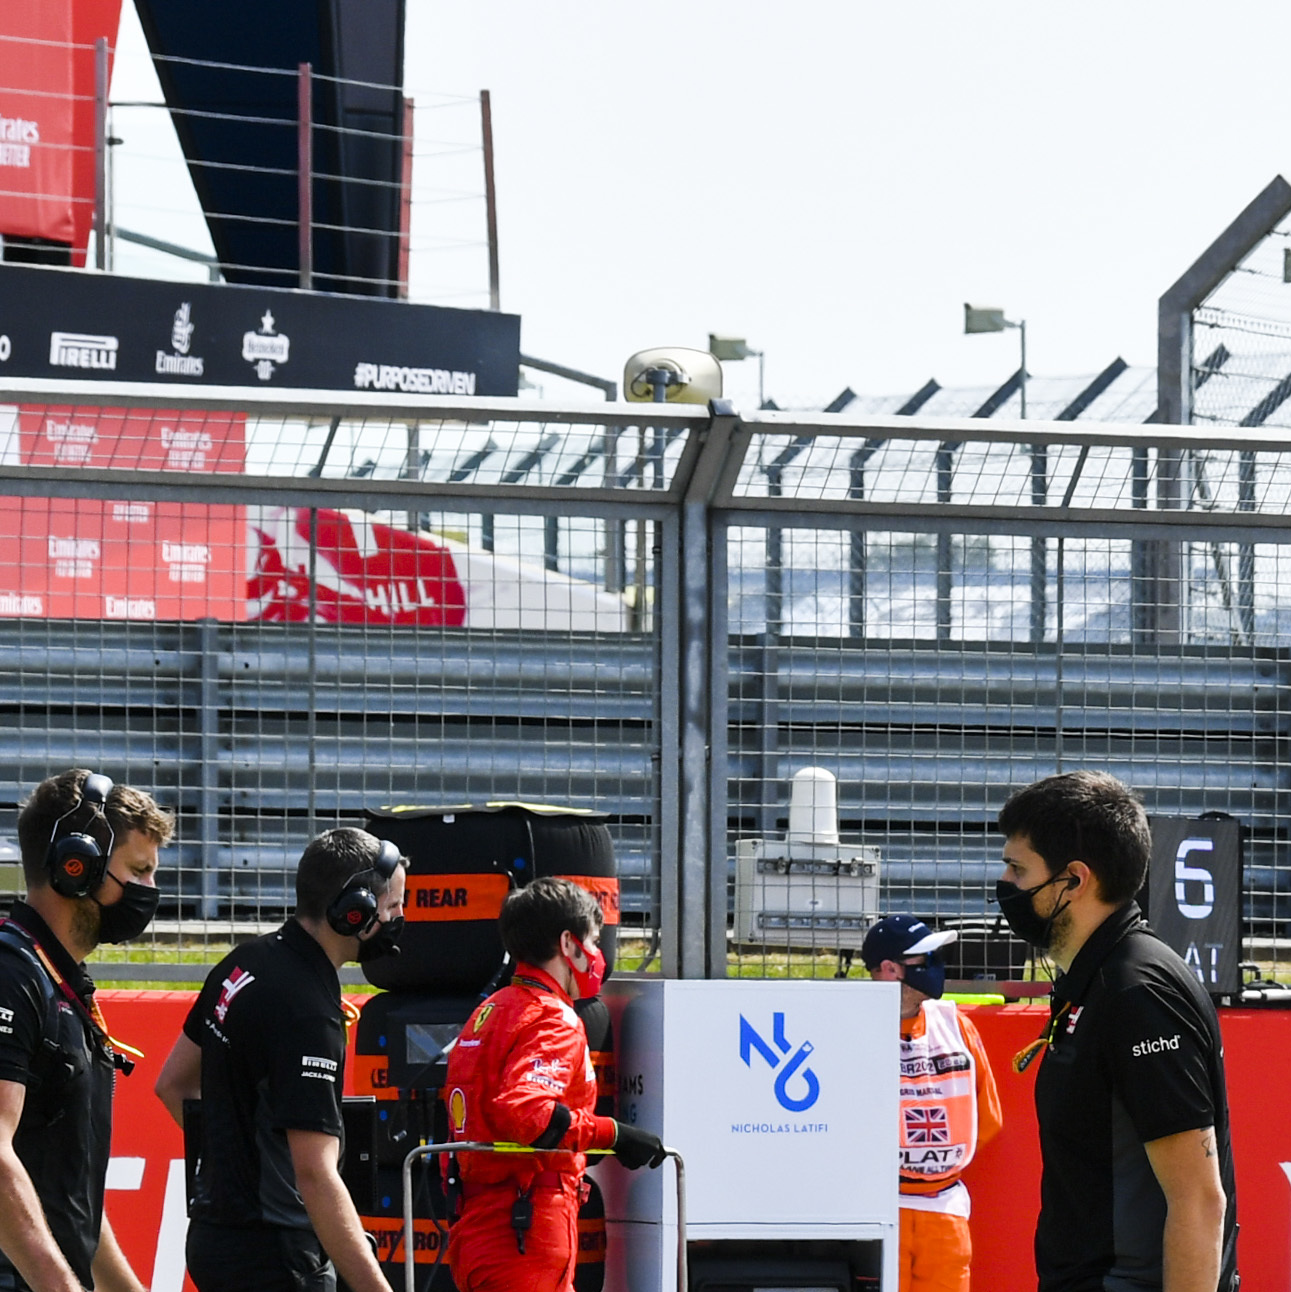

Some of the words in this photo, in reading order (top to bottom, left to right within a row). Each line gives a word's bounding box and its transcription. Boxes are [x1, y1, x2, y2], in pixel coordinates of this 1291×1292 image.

[0, 117, 40, 145] rates
[49, 331, 119, 370] PIRELLI
[155, 350, 204, 377] Emirates
[354, 362, 477, 396] #PURPOSEDRIVEN
[0, 592, 43, 616] mirates
[1174, 836, 1215, 920] 6
[415, 887, 468, 908] REAR
[1184, 940, 1224, 984] AT
[731, 1123, 791, 1134] NICHOLAS
[794, 1123, 828, 1134] LATIFI
